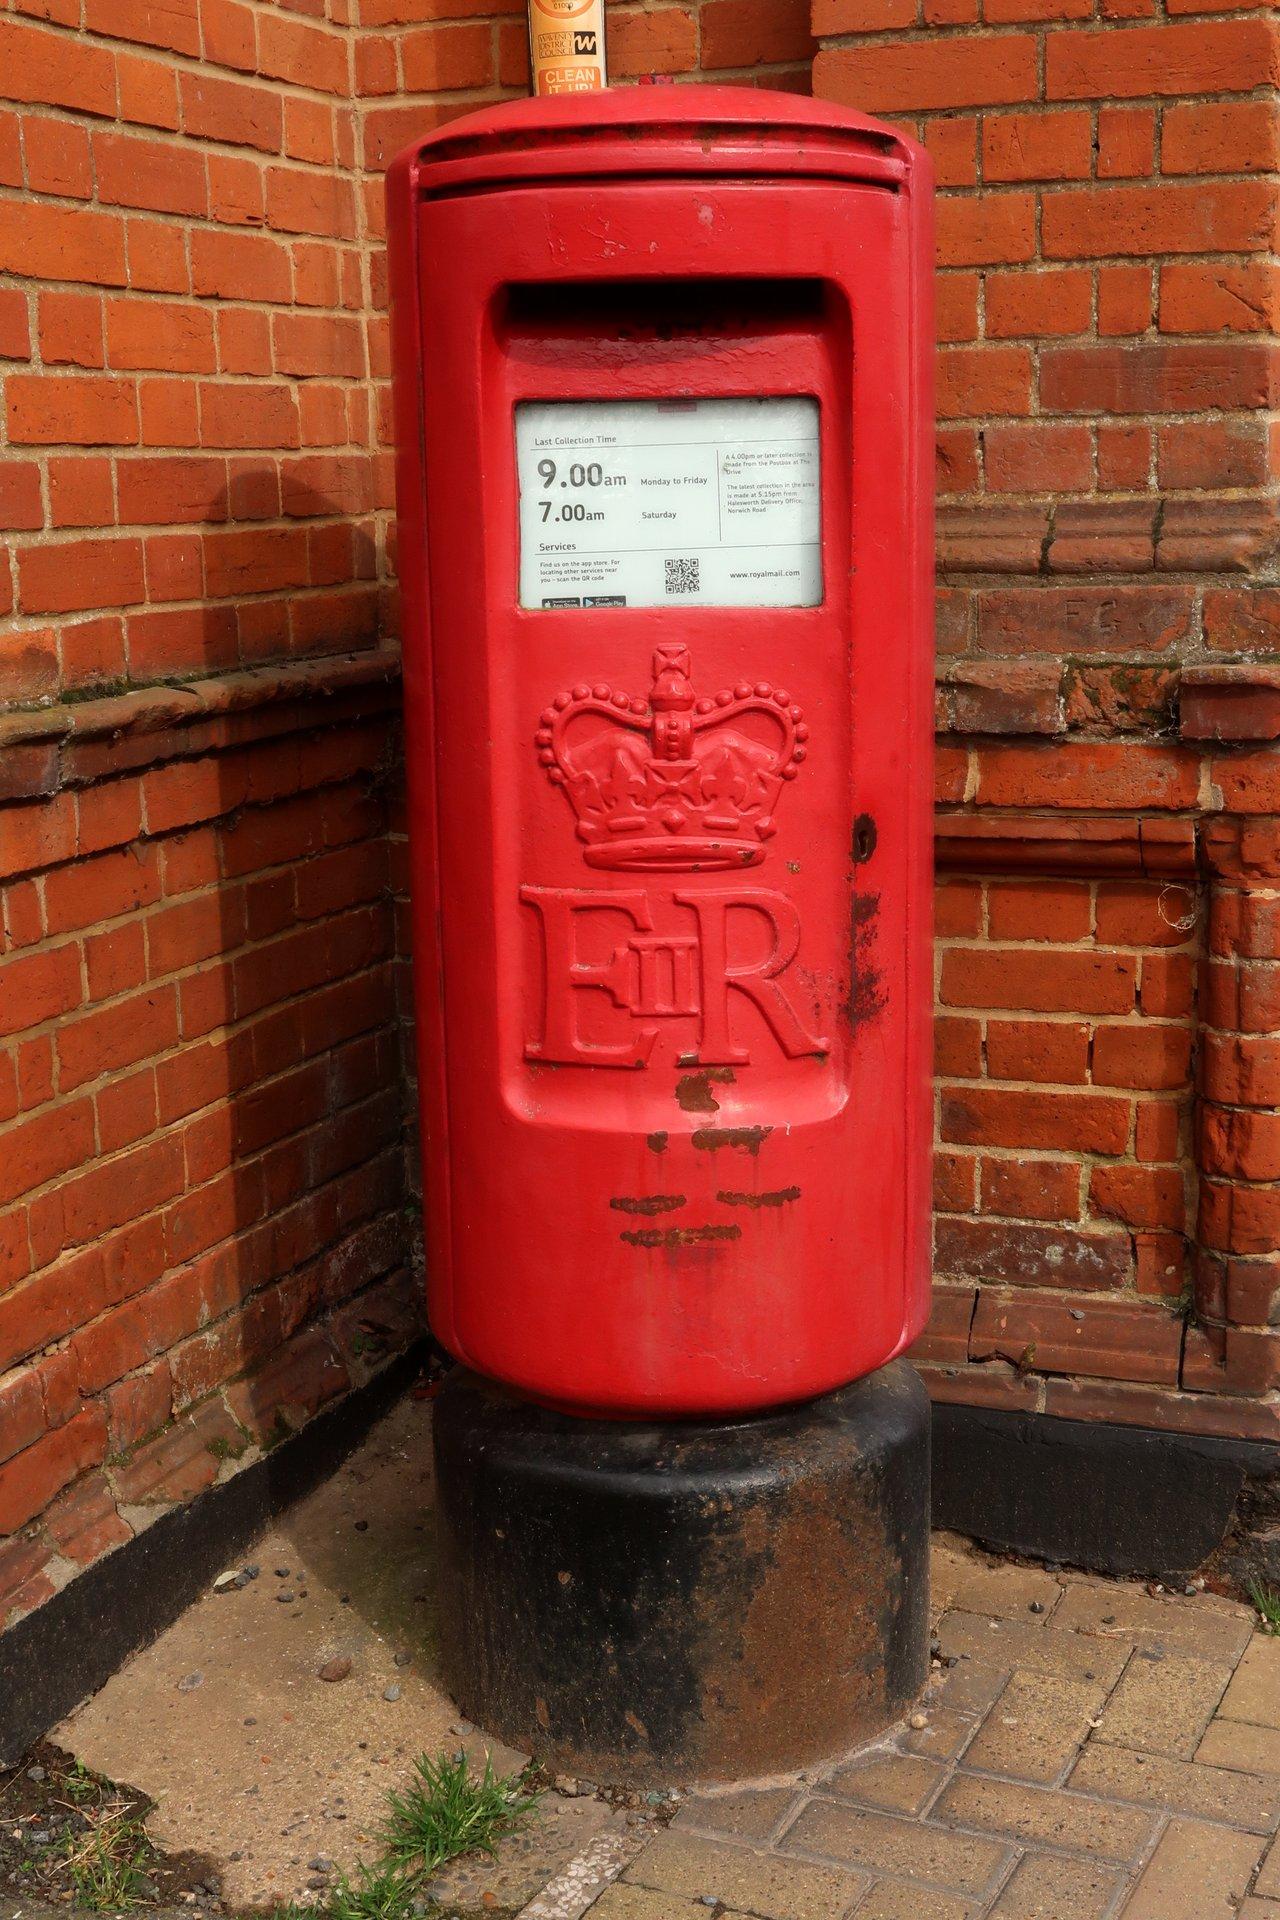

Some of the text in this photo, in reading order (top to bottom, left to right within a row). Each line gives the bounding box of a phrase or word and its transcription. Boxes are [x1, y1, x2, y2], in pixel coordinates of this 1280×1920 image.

[545, 68, 595, 83] CLEAN
[549, 85, 561, 94] IT
[535, 435, 616, 446] Last Collection Time
[537, 459, 627, 489] 9.00am
[641, 478, 670, 486] Monday
[684, 476, 708, 485] Friday
[538, 501, 677, 523] 7.00am Saturday
[540, 543, 576, 551] Services
[730, 570, 800, 579] www.royalmail.com
